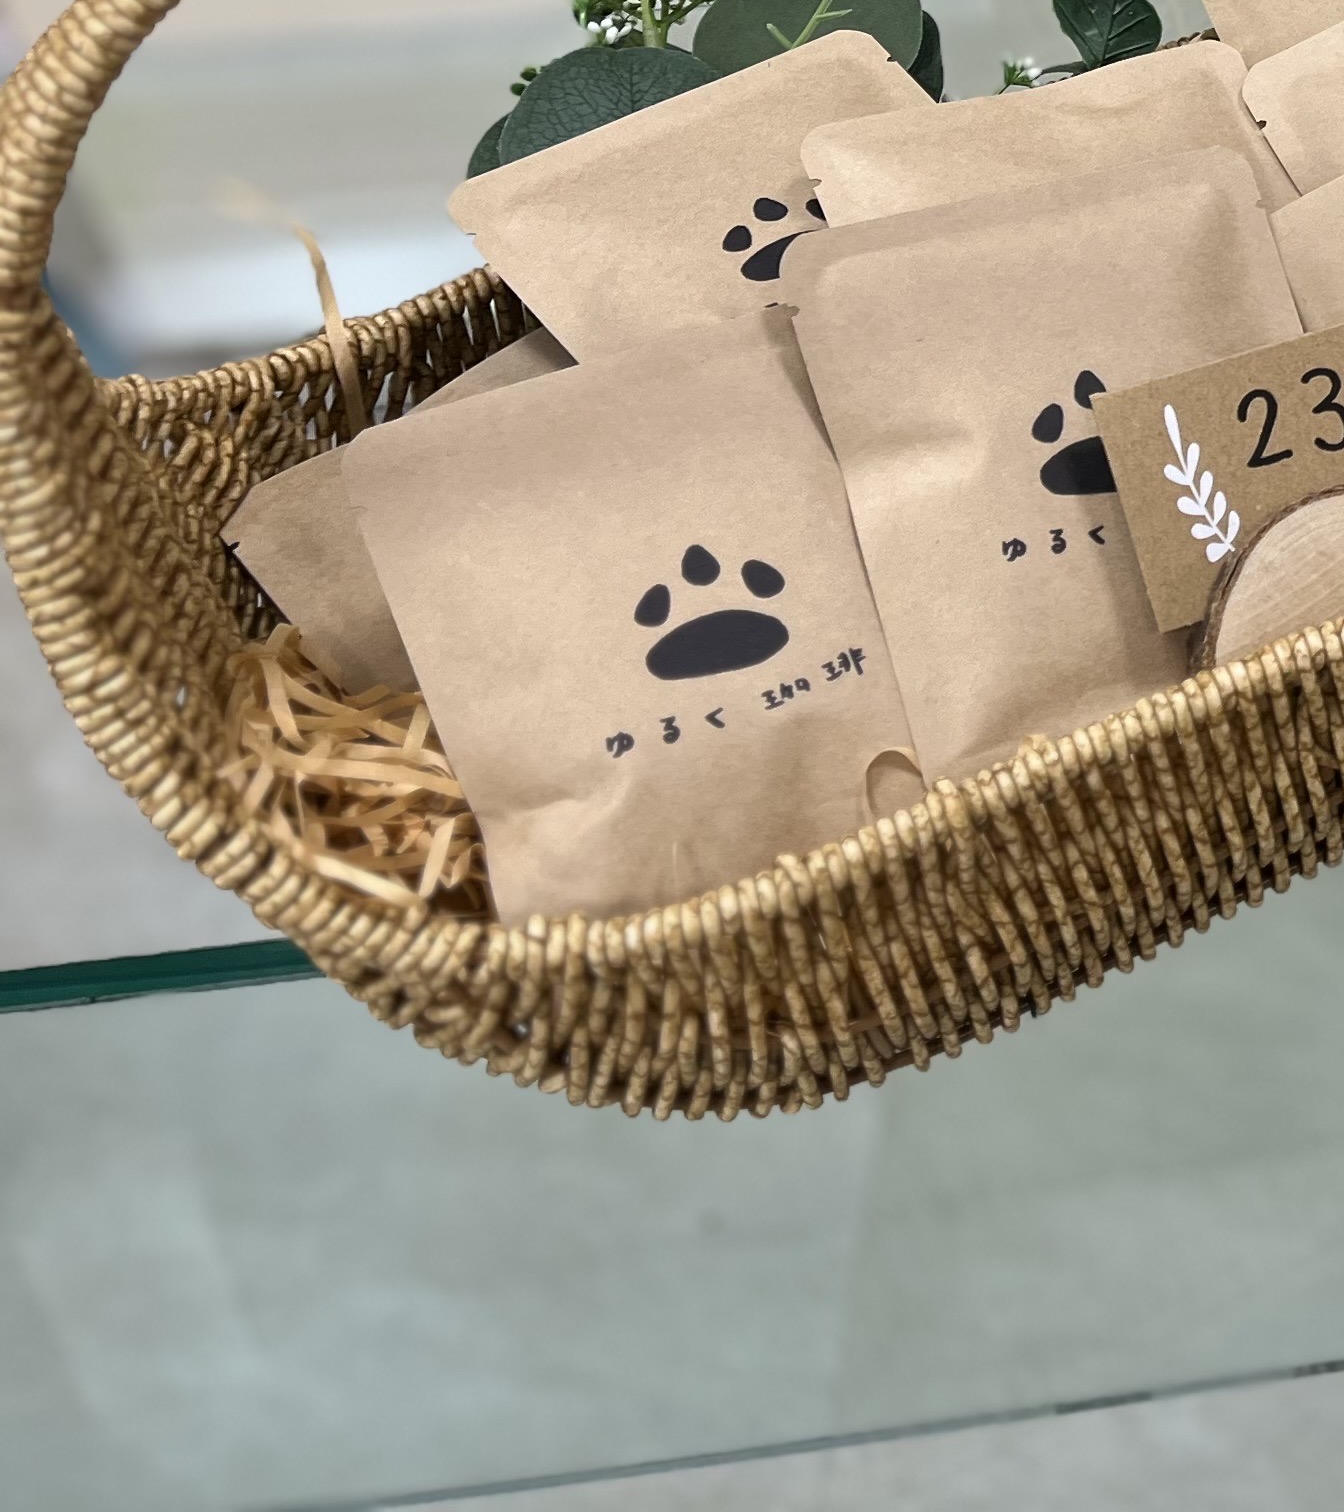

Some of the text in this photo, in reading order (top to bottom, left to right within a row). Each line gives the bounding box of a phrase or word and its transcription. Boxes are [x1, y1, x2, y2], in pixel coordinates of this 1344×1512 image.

[605, 646, 867, 759] ゆるく珈琲
